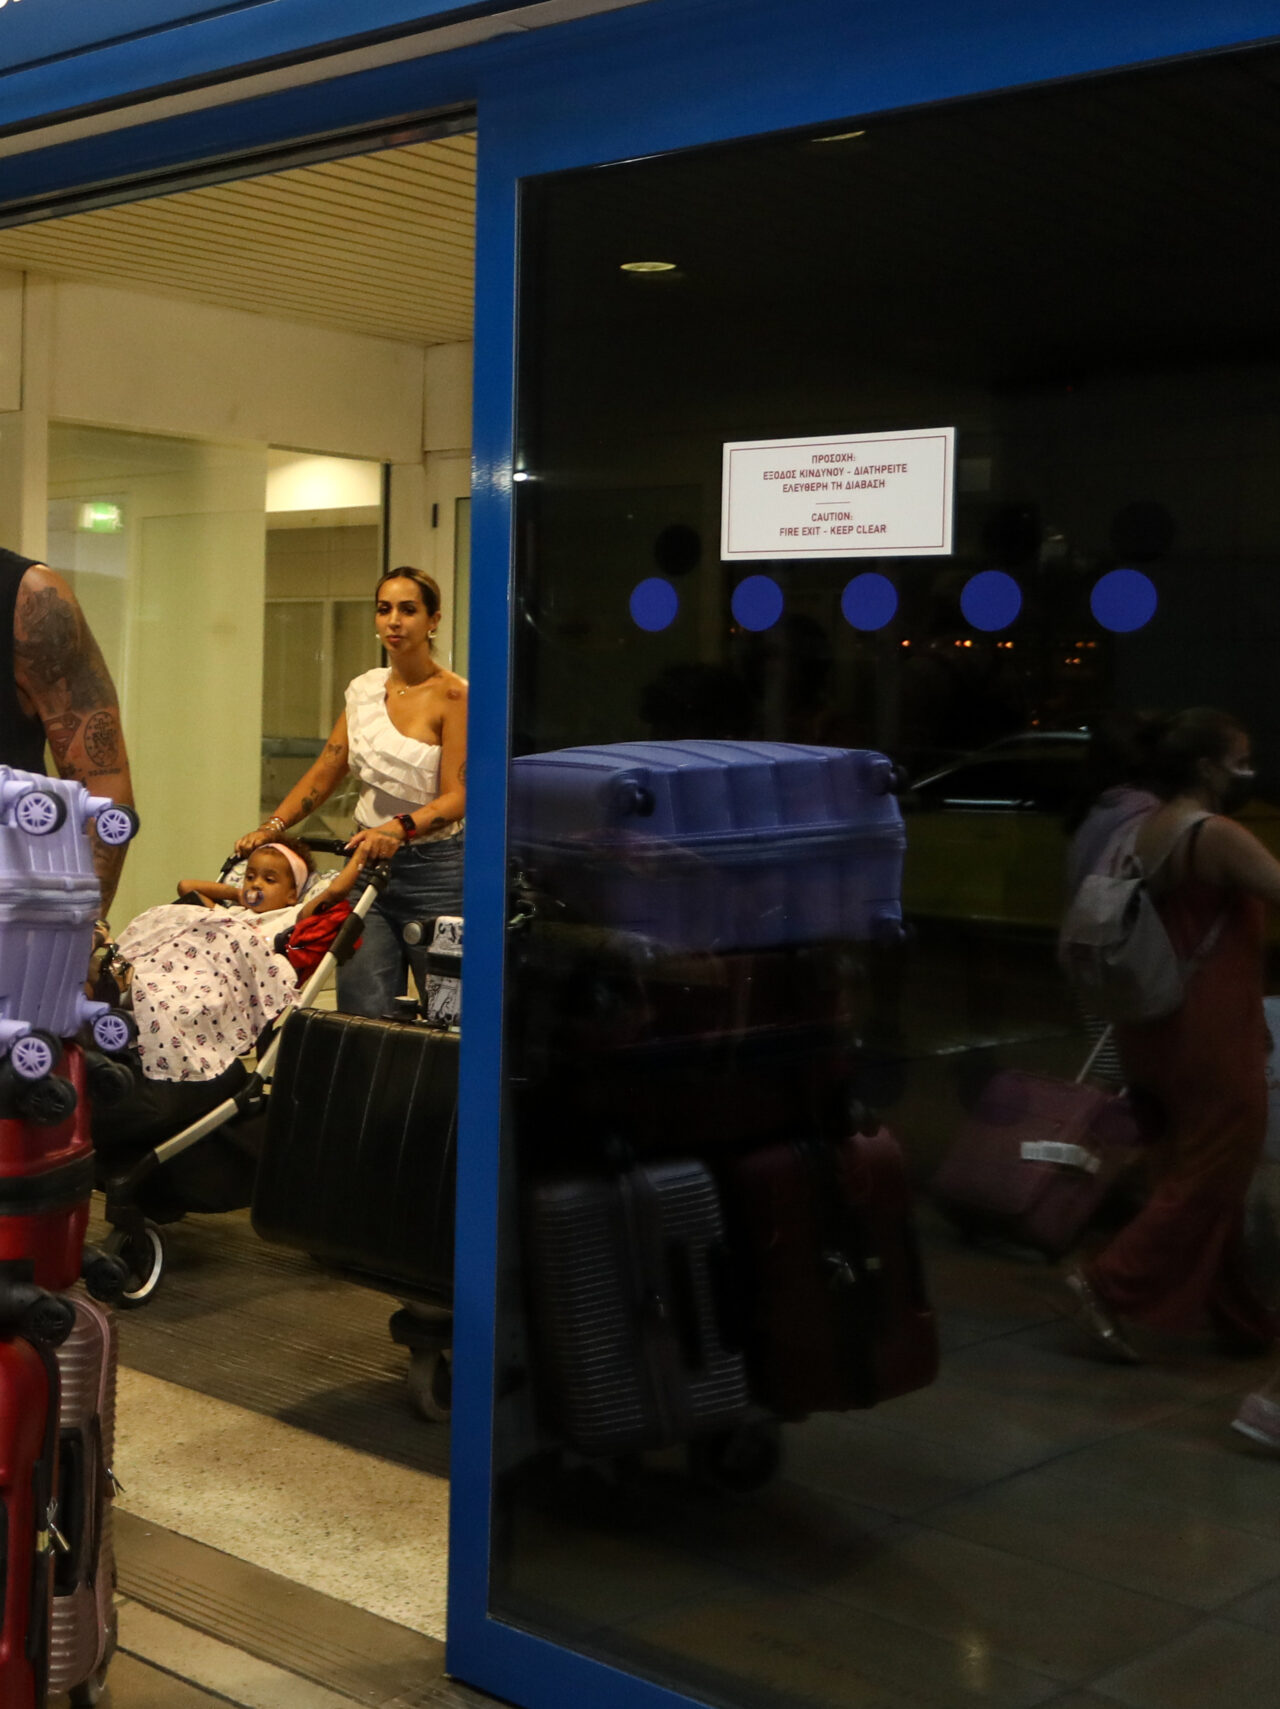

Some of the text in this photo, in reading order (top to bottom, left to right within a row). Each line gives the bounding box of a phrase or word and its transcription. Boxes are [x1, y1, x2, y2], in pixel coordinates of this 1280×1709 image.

[812, 453, 856, 464] ΠΡΟΣΟΧΗ:
[763, 469, 797, 480] ΕΞΟΔΟΣ
[799, 467, 845, 478] ΚΙΝΔΥΝΟΥ
[854, 464, 908, 476] ΔΙΑΤΗΡΕΙΤΕ
[782, 479, 885, 493] ΕΛΕΥΘΕΡΗ ΤΗ ΔΙΑΒΑΣΗ
[811, 512, 853, 522] CAUTION:
[780, 527, 799, 536] FIRE
[801, 526, 820, 536] EXIT
[830, 525, 854, 535] KEEP
[856, 524, 887, 534] CLEAR
